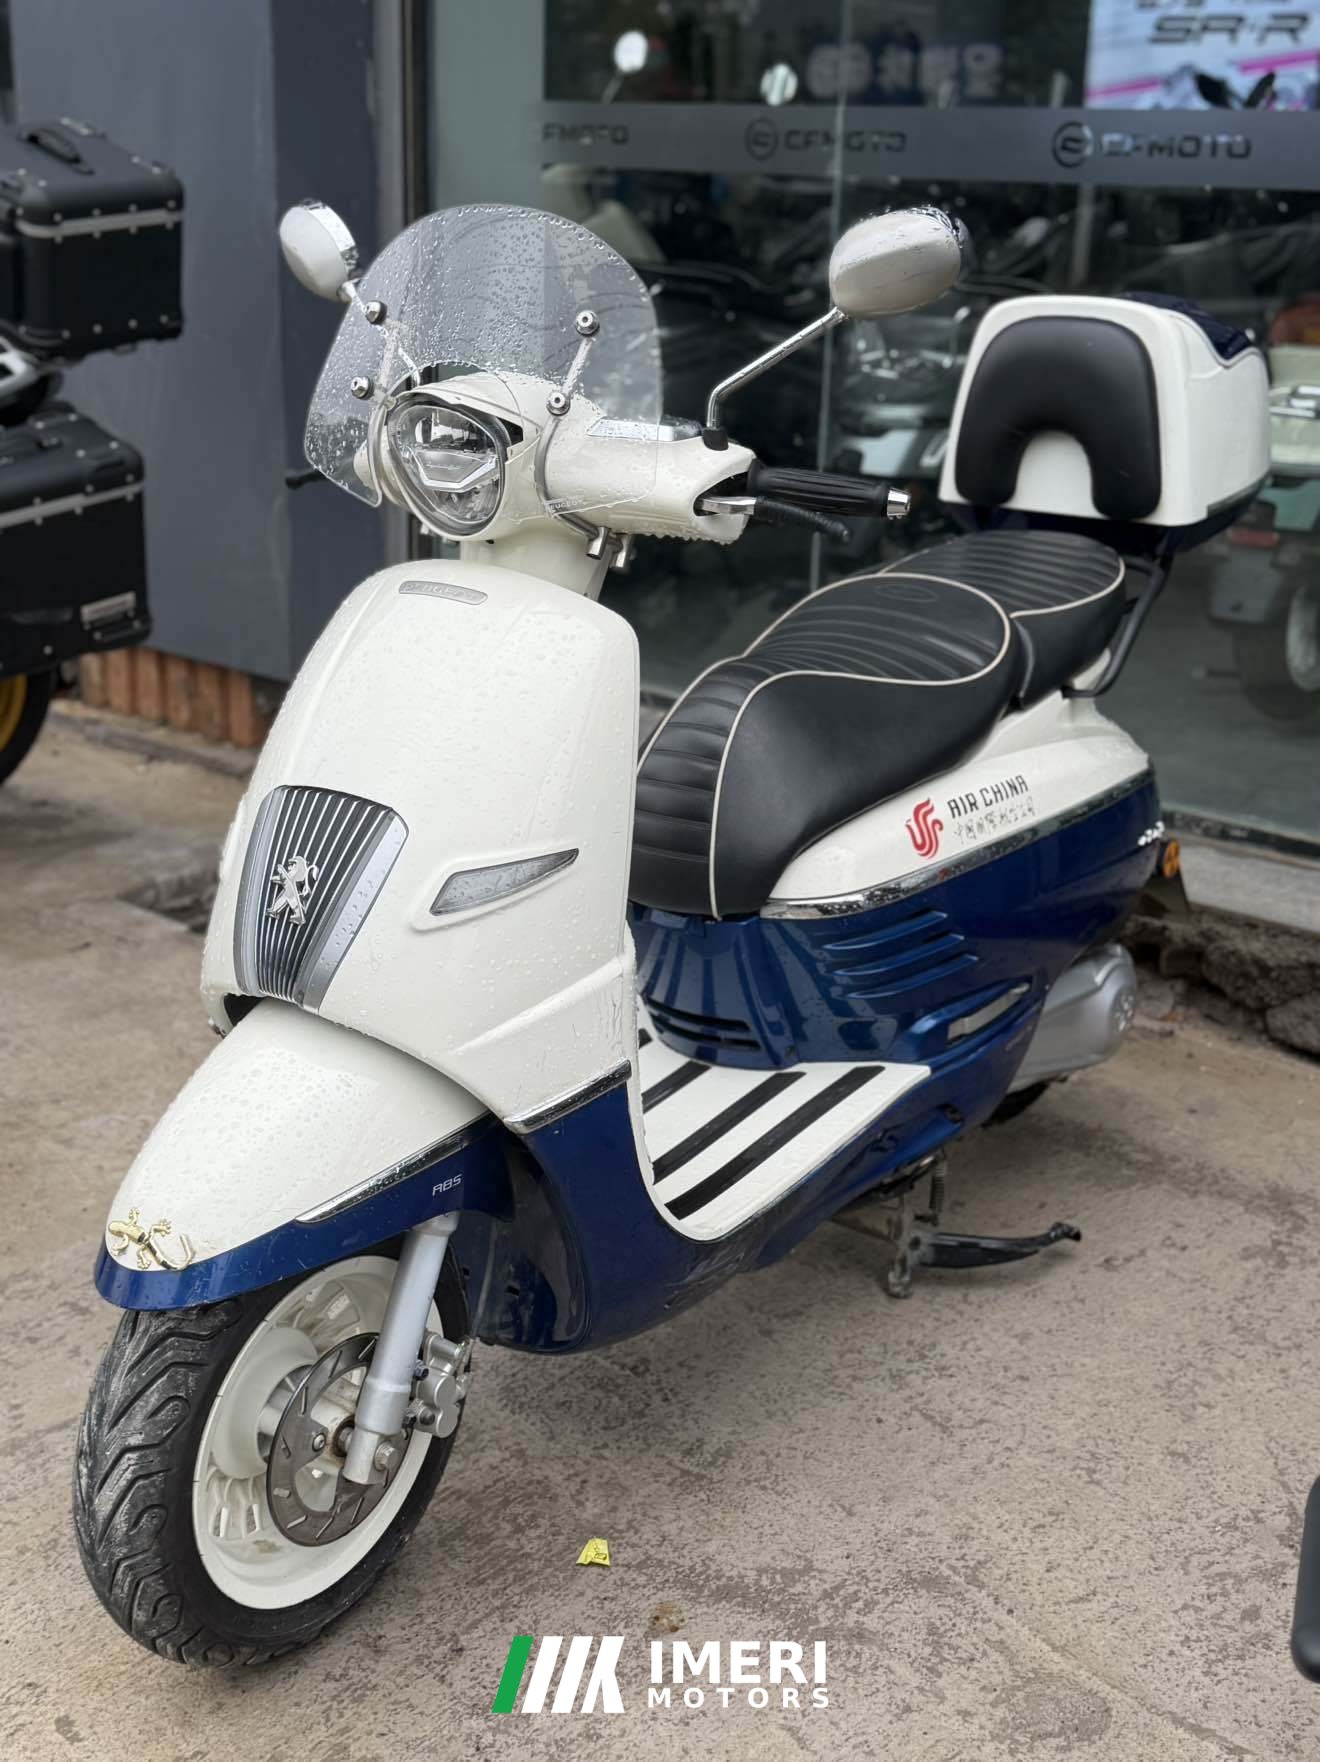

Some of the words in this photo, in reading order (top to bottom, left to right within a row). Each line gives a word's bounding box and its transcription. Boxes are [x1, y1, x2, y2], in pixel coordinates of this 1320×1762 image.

[947, 792, 979, 819] AIR
[979, 775, 1029, 807] CHINA
[432, 1173, 463, 1196] ABS
